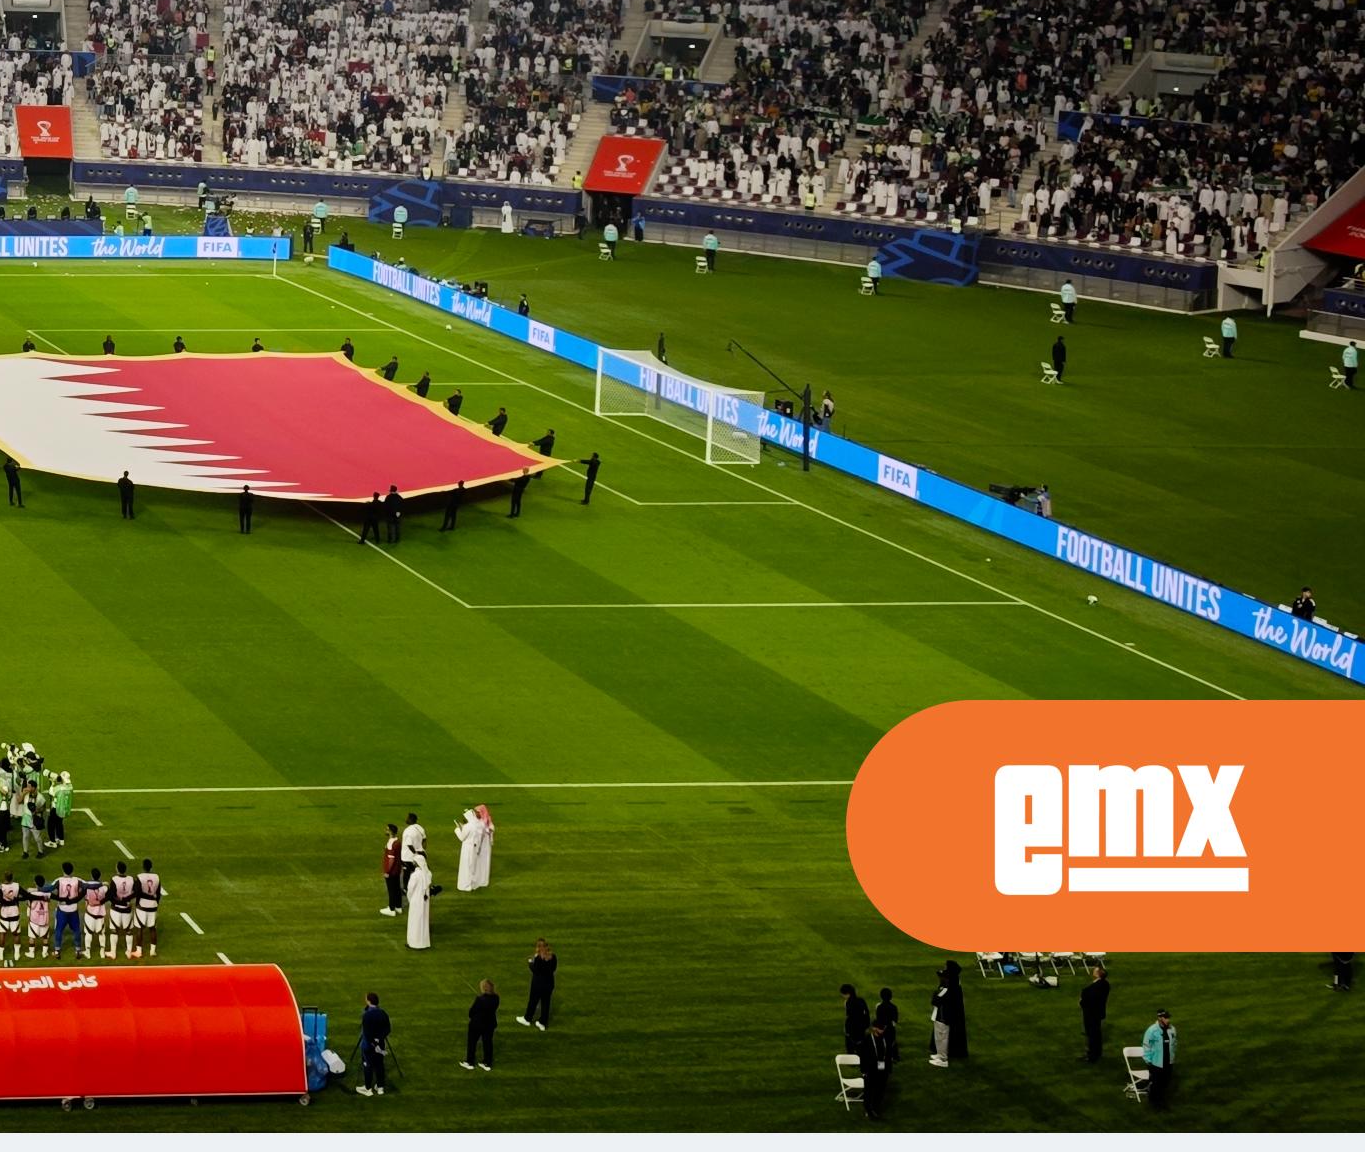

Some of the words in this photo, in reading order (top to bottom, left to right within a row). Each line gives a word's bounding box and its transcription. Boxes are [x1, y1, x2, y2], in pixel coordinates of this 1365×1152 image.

[14, 236, 68, 257] UNITES
[92, 236, 118, 256] the
[119, 236, 166, 258] World
[203, 241, 232, 253] FIFA
[372, 260, 411, 298] FOOTBALL
[411, 273, 441, 307] UNITES
[451, 291, 465, 314] the
[465, 294, 492, 328] World
[532, 327, 551, 345] FIFA
[639, 367, 695, 408] FOTBALL
[756, 410, 779, 439] the
[779, 417, 819, 459] Word
[883, 463, 911, 489] FIFA
[1056, 525, 1147, 593] FOOTBALL
[1151, 561, 1222, 622] UNITES
[1252, 606, 1288, 645] the
[1292, 618, 1357, 679] World
[3, 975, 55, 993] العرب
[57, 973, 99, 991] كأس
